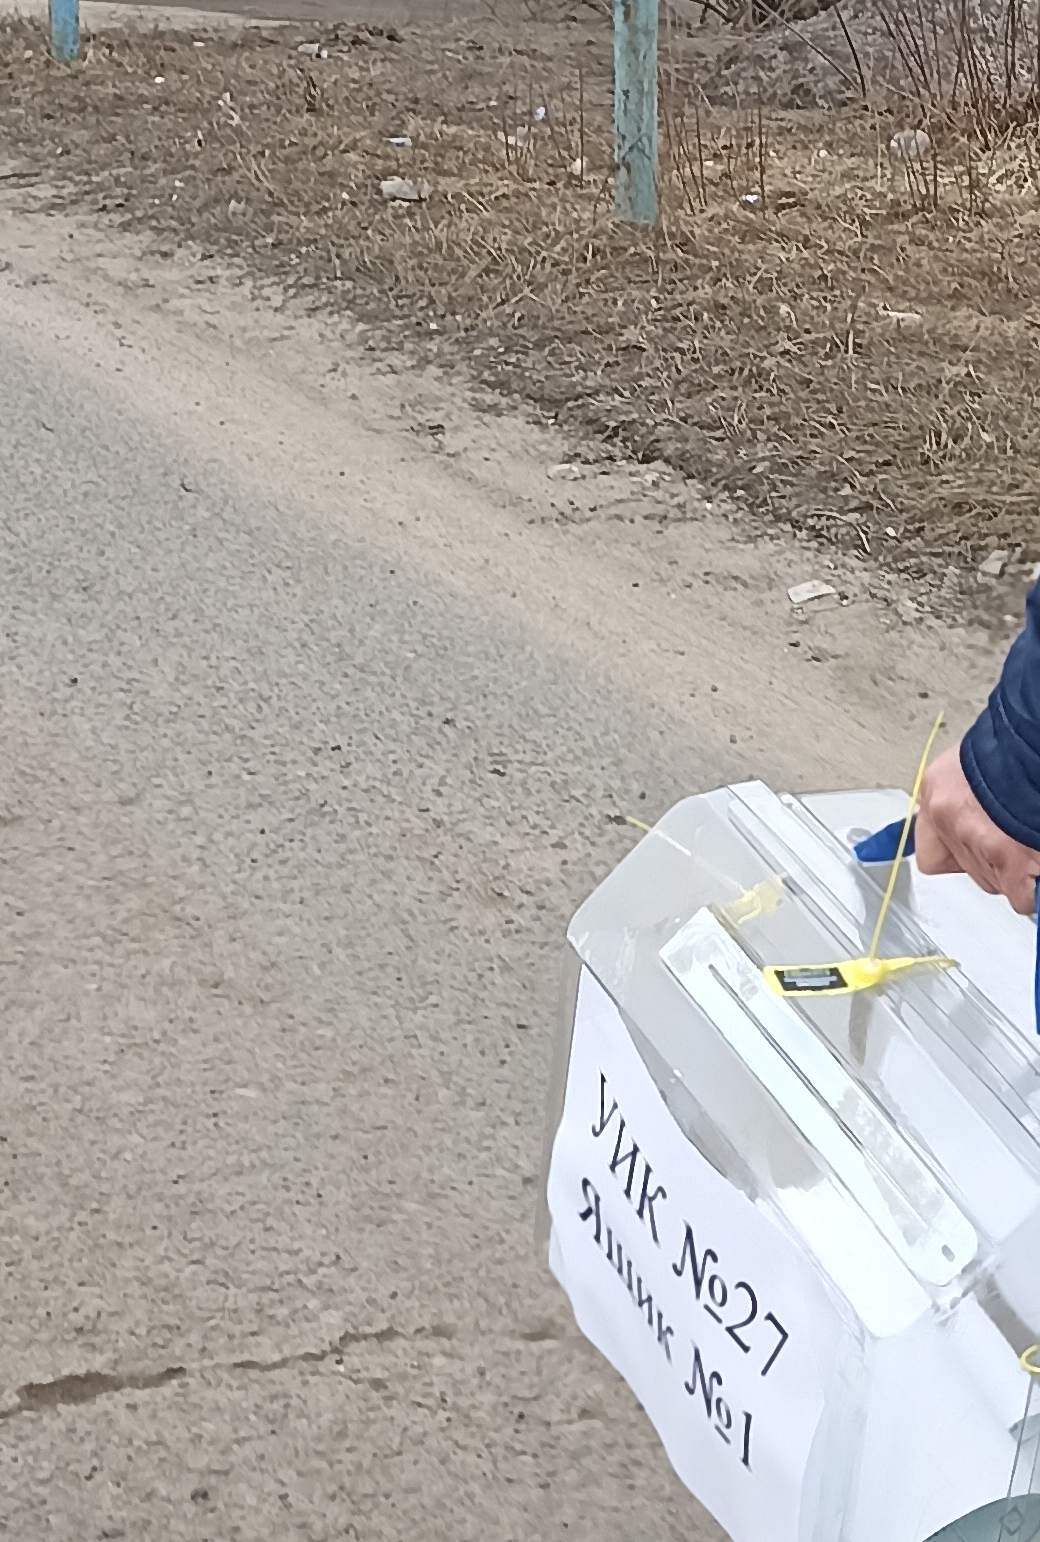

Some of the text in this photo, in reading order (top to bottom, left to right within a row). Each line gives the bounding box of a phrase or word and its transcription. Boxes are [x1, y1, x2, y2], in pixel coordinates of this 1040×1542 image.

[578, 1177, 754, 1473] Ящик №1
[592, 1067, 789, 1377] УИК №27
